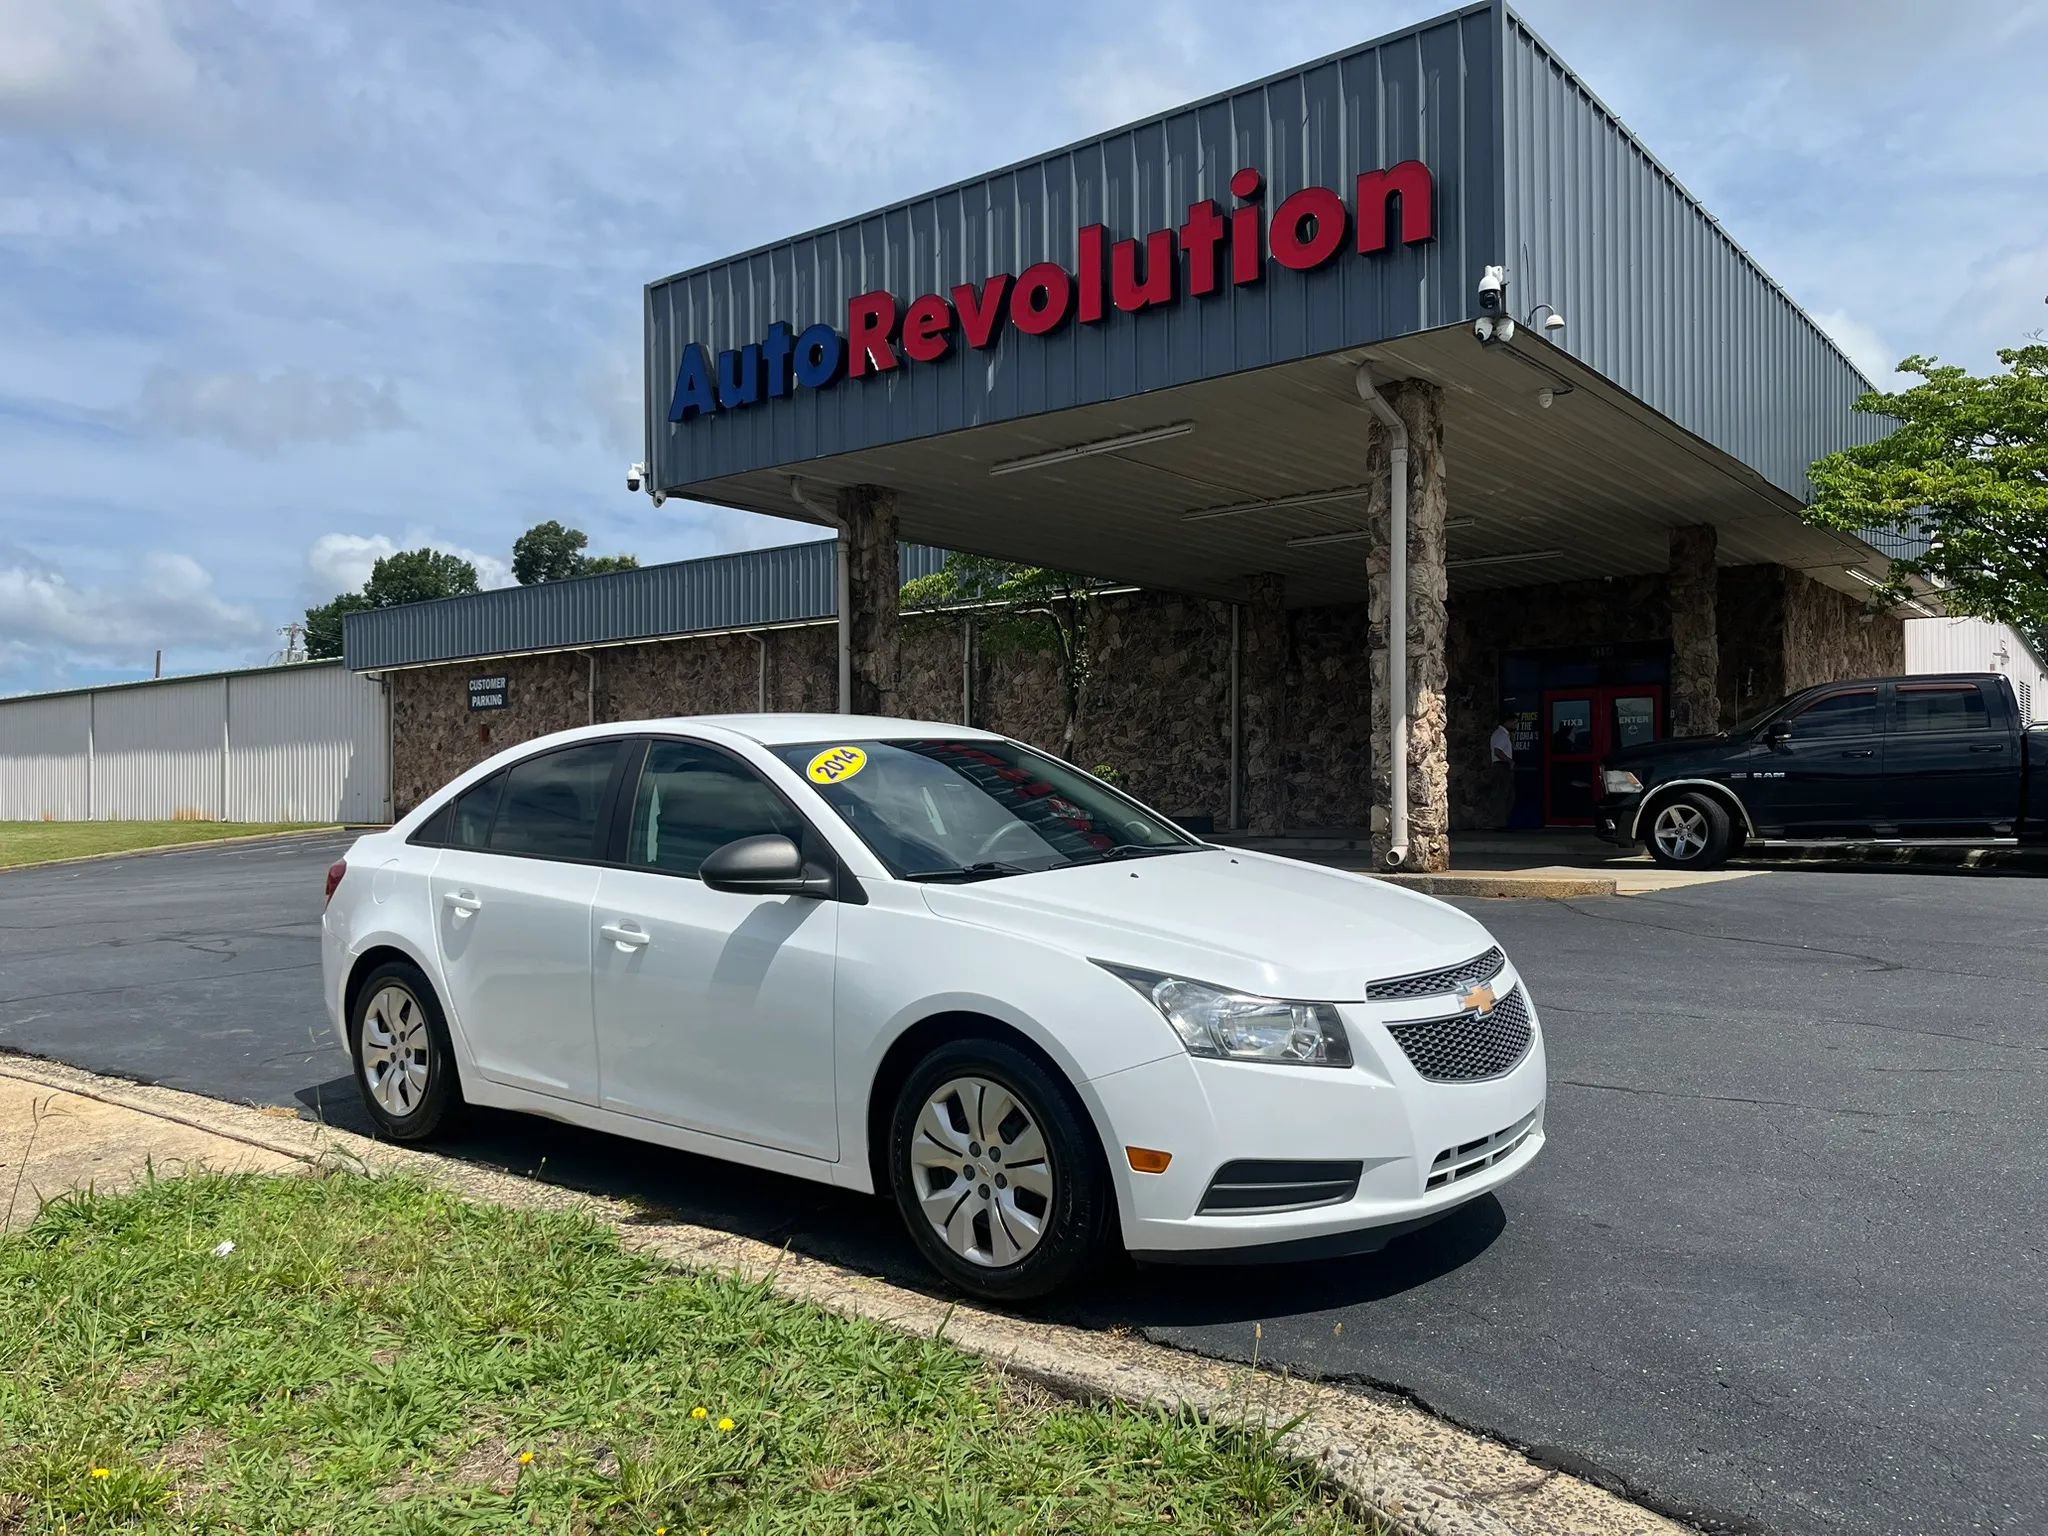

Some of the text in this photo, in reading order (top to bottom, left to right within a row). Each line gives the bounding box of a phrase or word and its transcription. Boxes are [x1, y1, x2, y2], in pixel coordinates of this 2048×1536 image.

[468, 677, 506, 691] CUSTOMER
[471, 694, 503, 707] PARKING
[1618, 715, 1649, 725] ENTER
[815, 748, 860, 780] 2014
